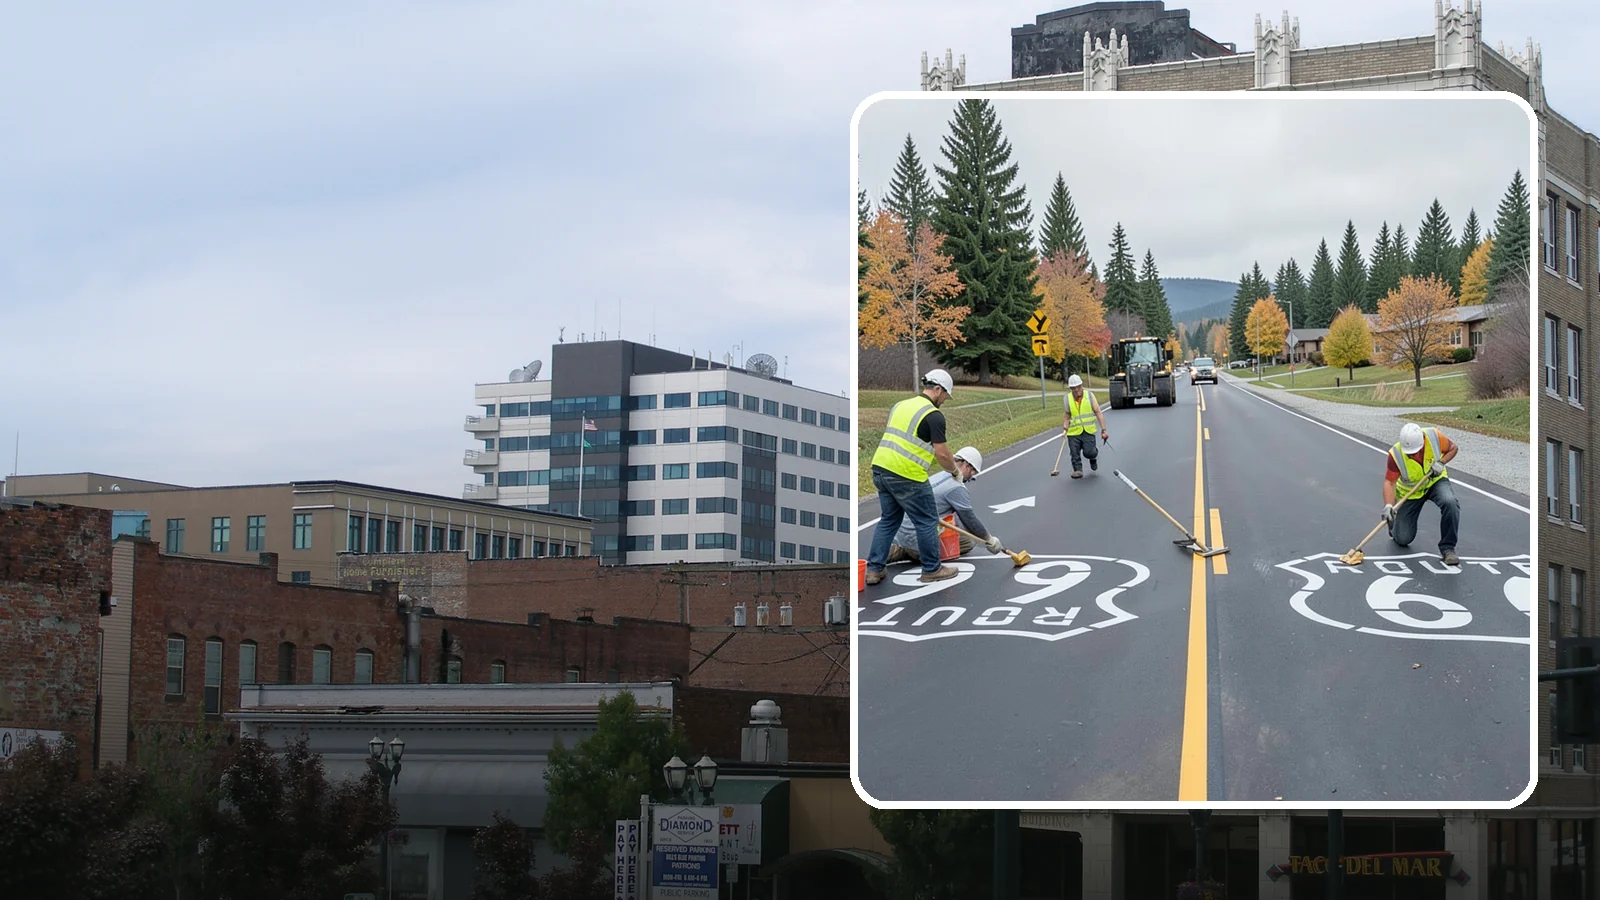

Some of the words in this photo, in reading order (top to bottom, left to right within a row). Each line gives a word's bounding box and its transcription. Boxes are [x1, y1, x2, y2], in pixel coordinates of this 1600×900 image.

[370, 566, 427, 576] Furnishers
[1365, 575, 1530, 629] 6
[858, 606, 1081, 626] ROUT
[660, 818, 713, 833] DIAMOND
[1022, 815, 1070, 828] BUILDING
[617, 825, 625, 852] PAY
[628, 825, 636, 852] PAY
[656, 845, 688, 853] RESERVED
[689, 846, 716, 854] PARKING
[722, 851, 739, 861] Soup
[627, 855, 636, 893] HERE
[671, 862, 701, 870] PATRONS
[1289, 855, 1331, 874] TAC
[1346, 856, 1385, 875] DEL
[1392, 857, 1443, 877] MAR
[616, 856, 625, 894] HERE
[660, 888, 682, 897] PUBLIC
[683, 889, 710, 898] PARKING
